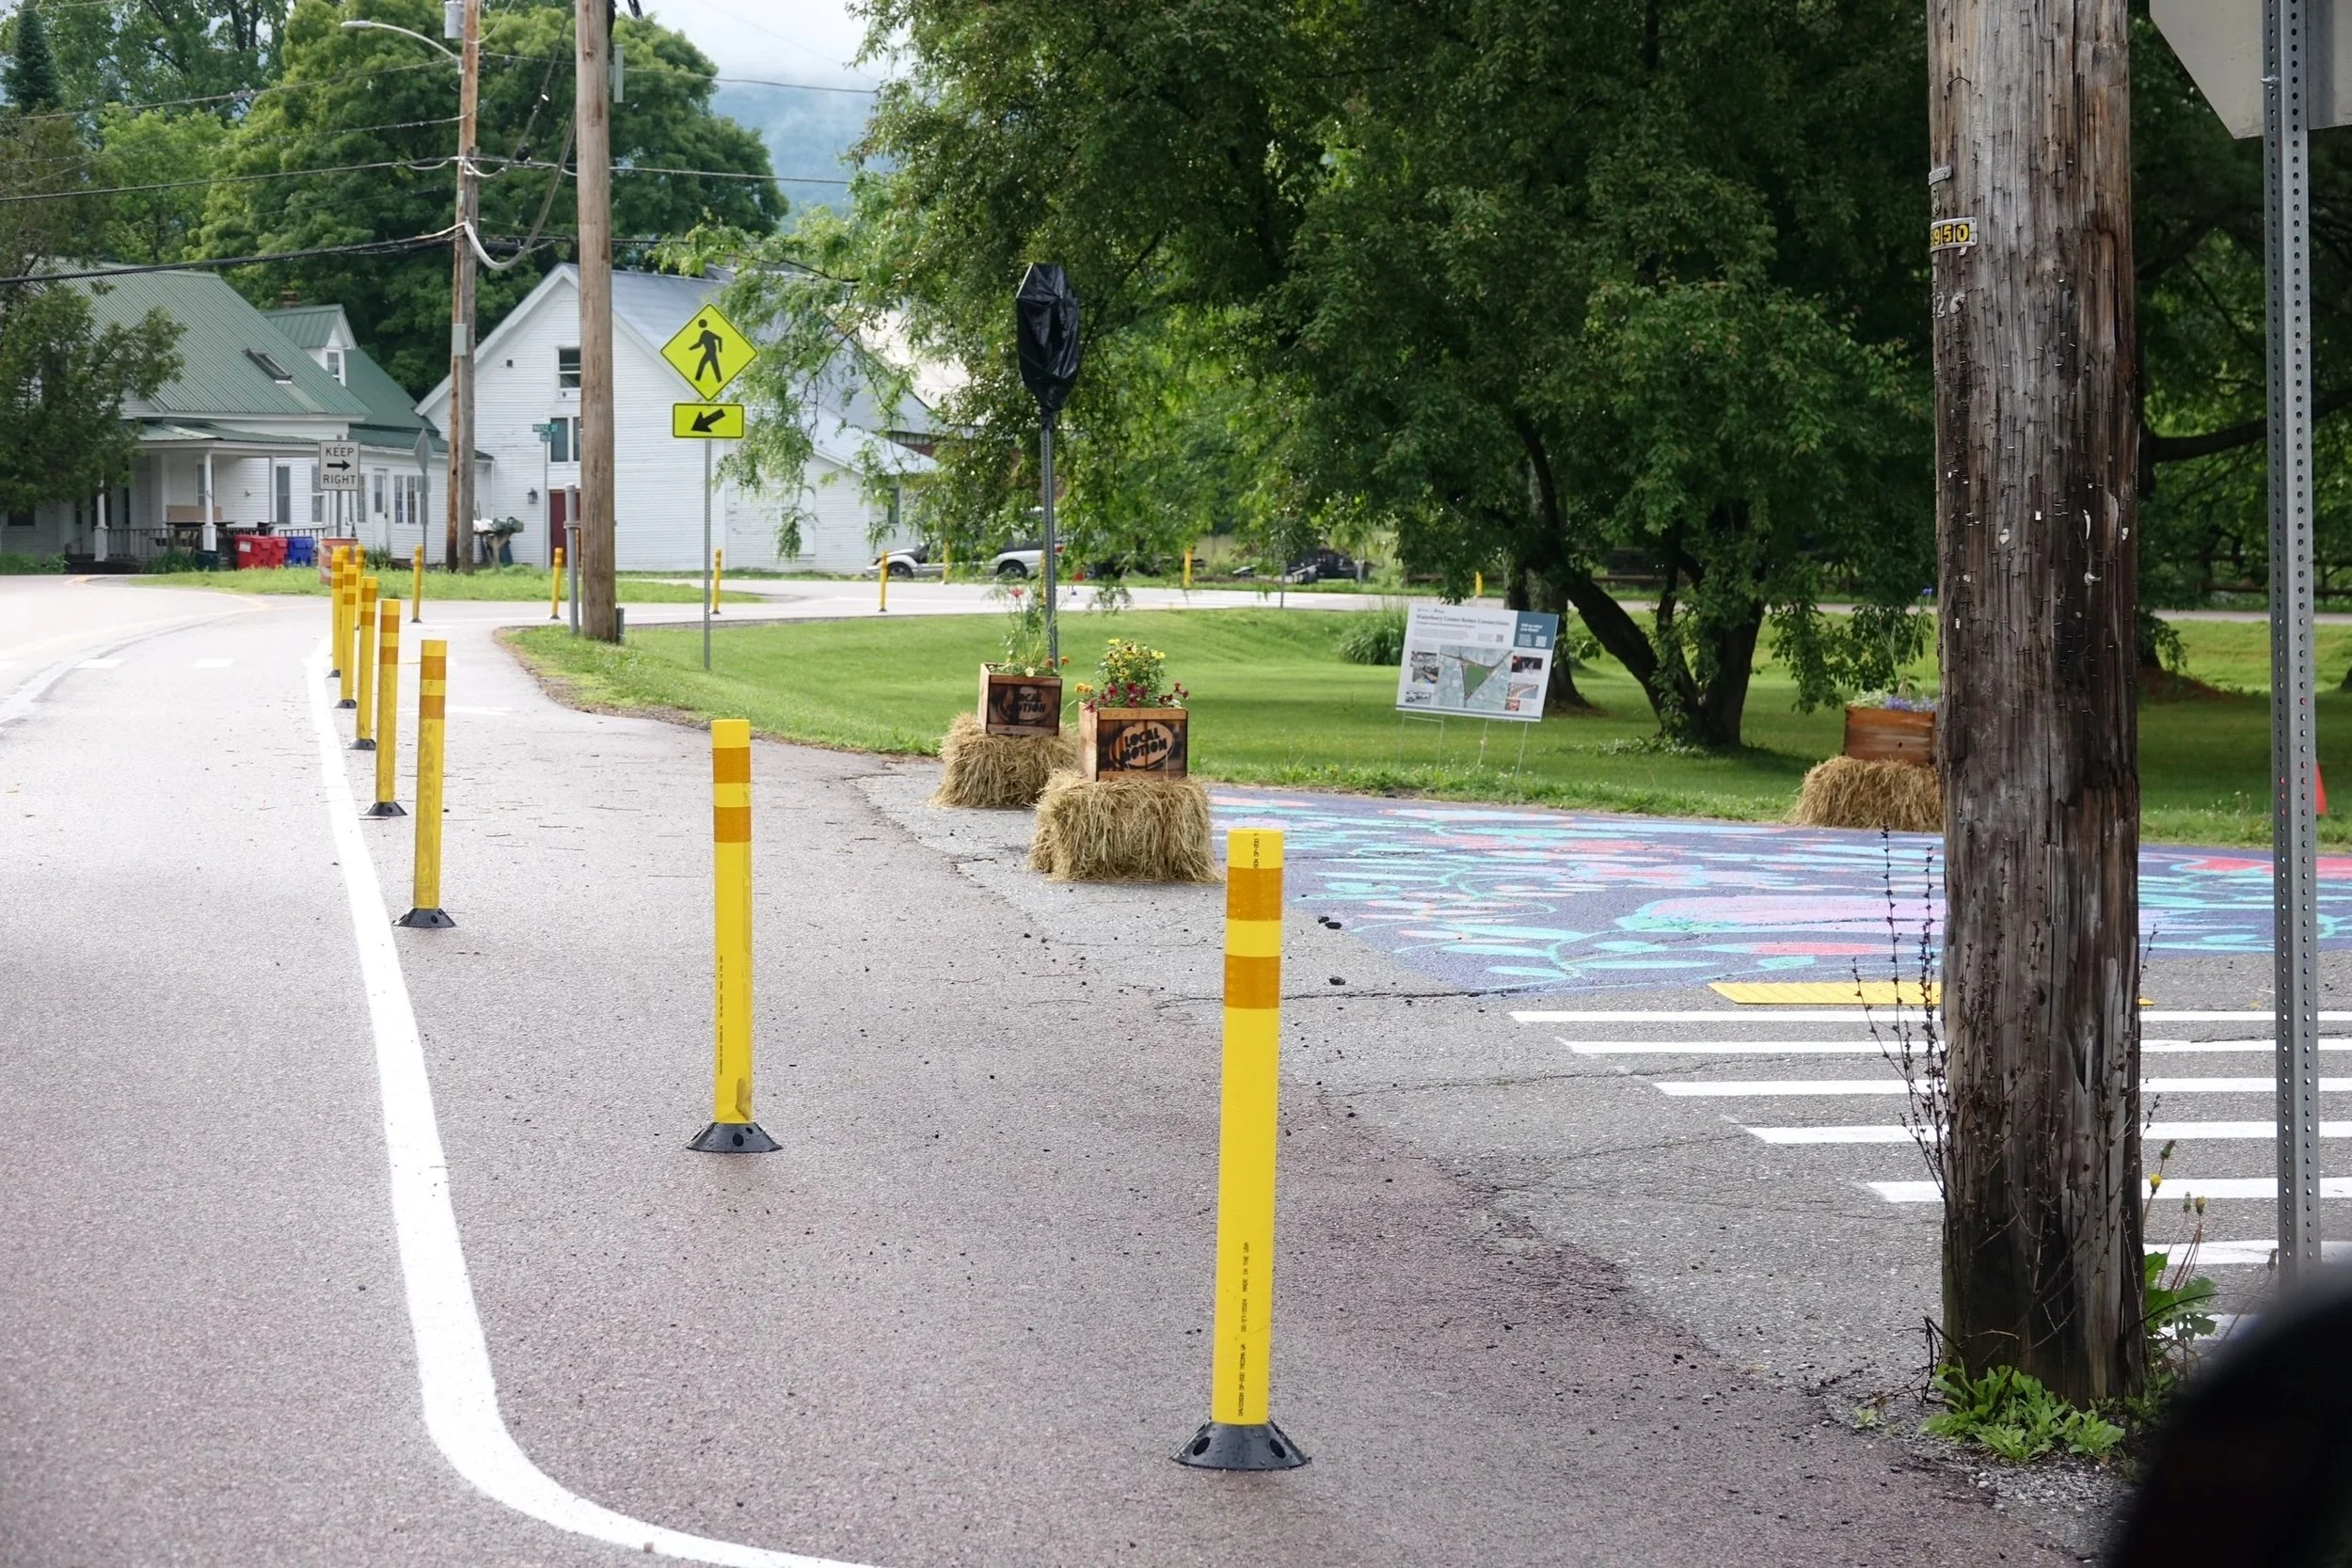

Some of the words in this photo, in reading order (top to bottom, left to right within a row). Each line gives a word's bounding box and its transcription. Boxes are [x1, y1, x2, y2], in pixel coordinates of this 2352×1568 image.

[326, 447, 354, 457] KEEP
[323, 474, 356, 484] RIGHT
[1124, 727, 1160, 749] LOCAL
[1120, 738, 1168, 768] MOTION
